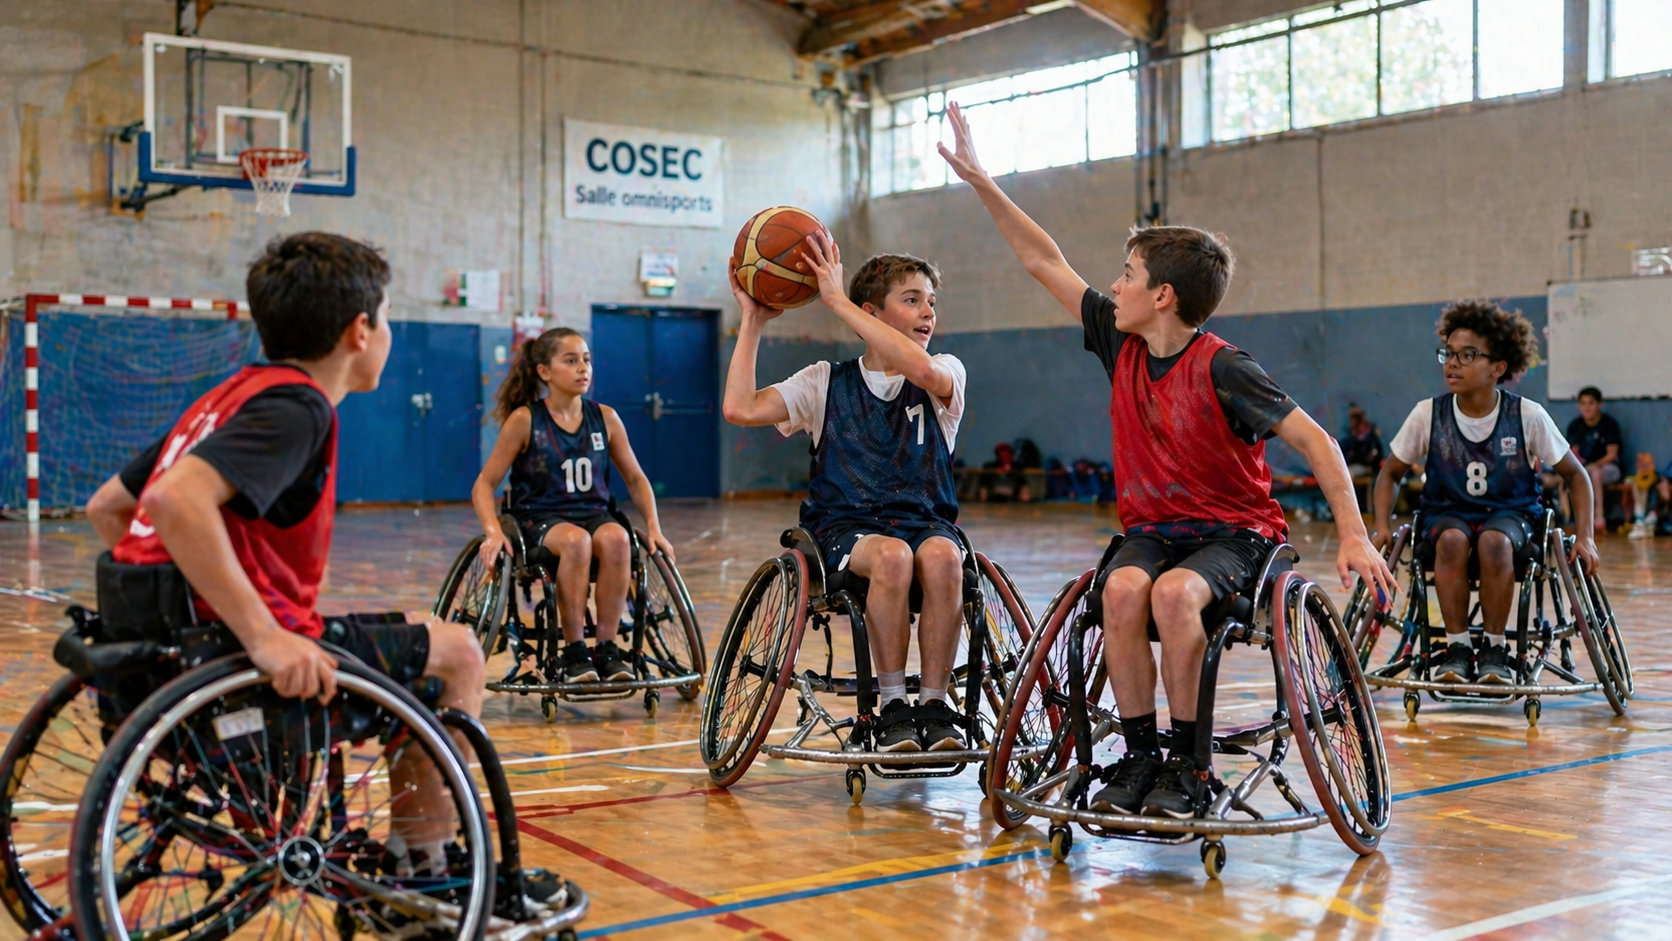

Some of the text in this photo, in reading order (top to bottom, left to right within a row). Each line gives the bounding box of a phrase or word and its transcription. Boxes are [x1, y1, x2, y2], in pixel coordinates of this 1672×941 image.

[586, 138, 703, 181] COSEC
[576, 184, 713, 214] Salle omnisports
[905, 403, 924, 445] 7
[561, 457, 593, 493] 10
[1466, 461, 1488, 496] 8
